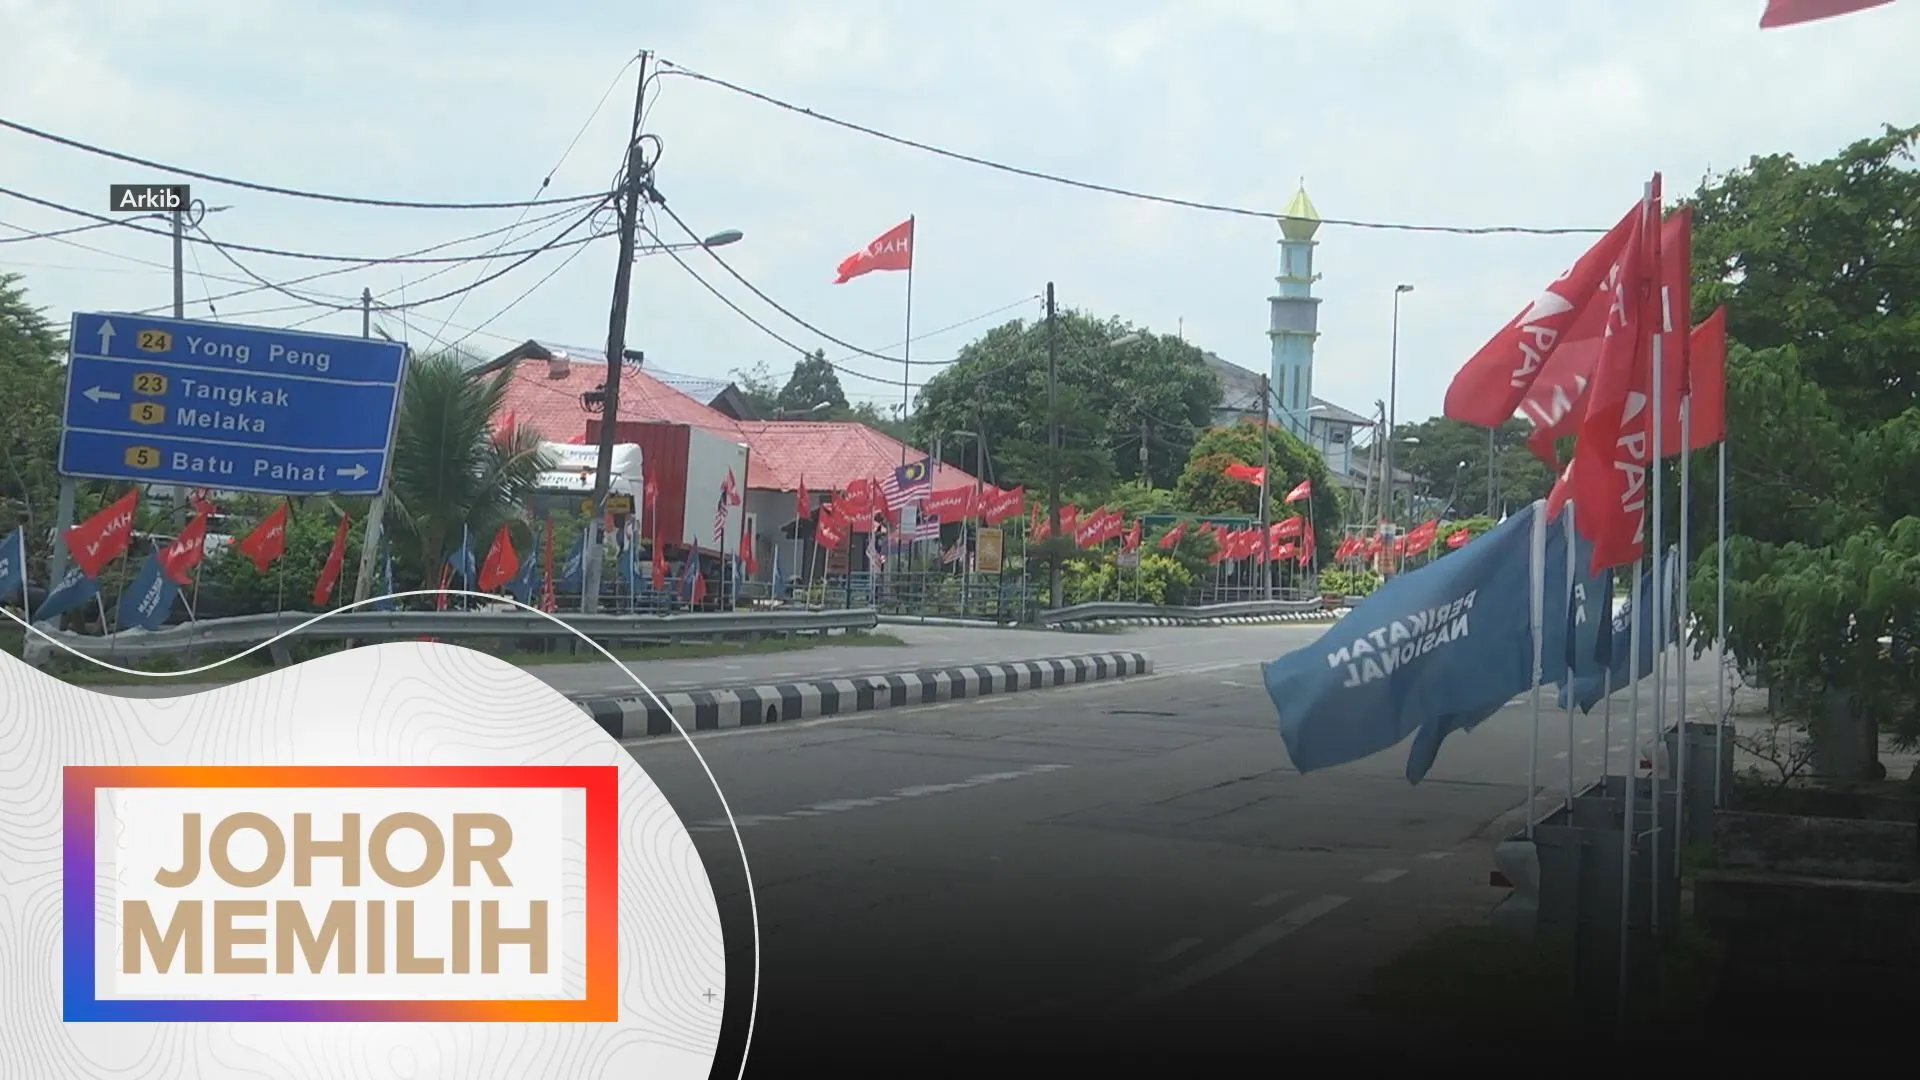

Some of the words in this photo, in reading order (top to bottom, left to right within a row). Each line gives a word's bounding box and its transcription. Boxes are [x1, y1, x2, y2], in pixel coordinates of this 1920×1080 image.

[142, 333, 166, 350] 24
[186, 336, 250, 364] Yong
[269, 344, 331, 371] Peng
[138, 375, 163, 392] 23
[181, 379, 289, 407] Tangkak
[142, 405, 153, 420] 5
[177, 408, 266, 433] Melaka
[137, 449, 148, 466] 5
[172, 452, 234, 475] Batu
[254, 460, 327, 481] Pahat
